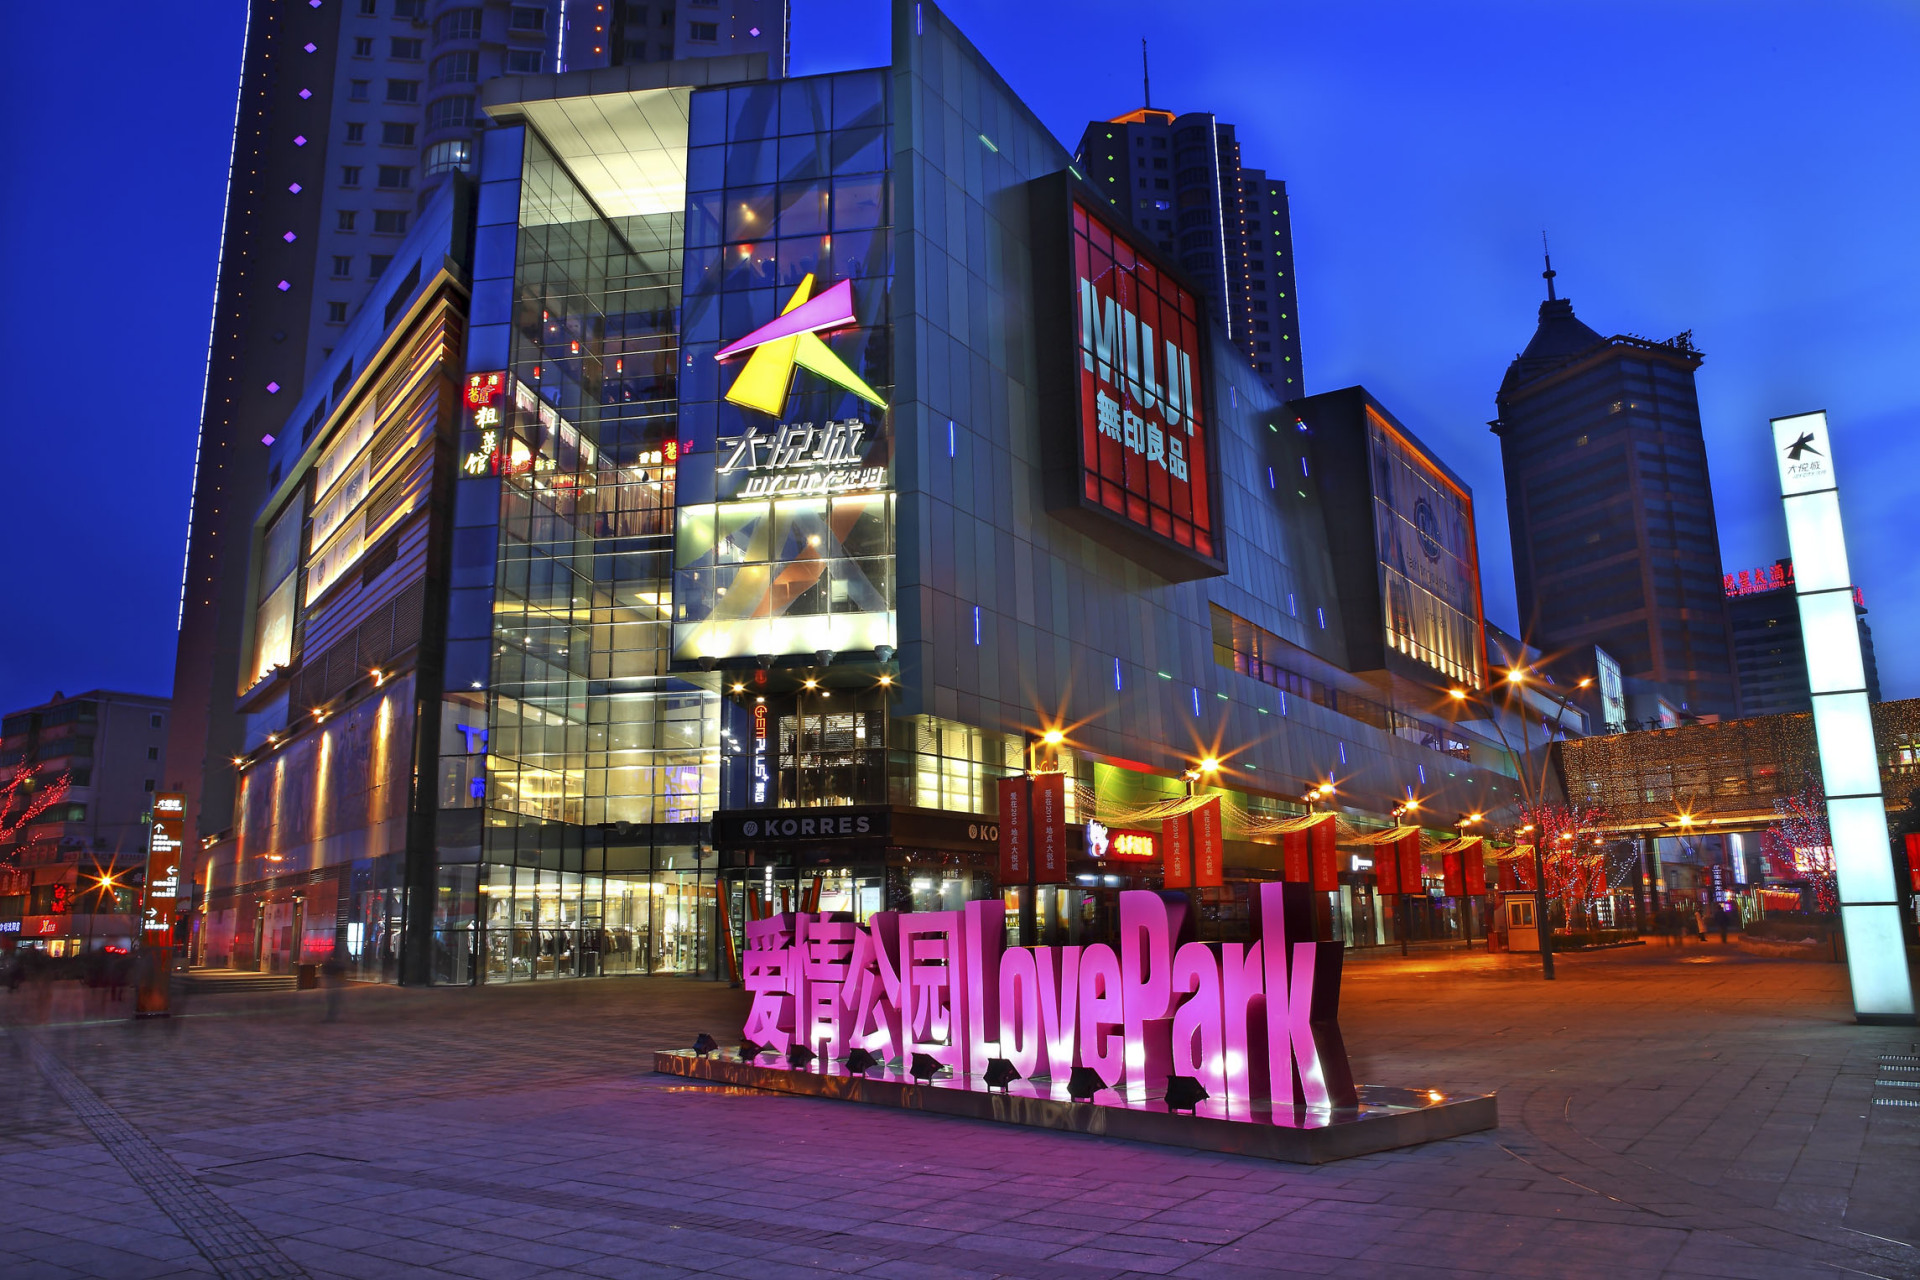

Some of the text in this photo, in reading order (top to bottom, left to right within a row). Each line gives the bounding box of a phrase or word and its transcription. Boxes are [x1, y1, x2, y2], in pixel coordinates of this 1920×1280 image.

[1080, 277, 1194, 437] MUJI
[464, 406, 498, 475] 粗菜馆
[716, 418, 865, 475] 大悦城
[1096, 389, 1189, 484] 無印良品
[765, 816, 870, 837] KORRES
[1011, 846, 1019, 872] 大悦城
[1044, 789, 1055, 870] 爱在2010 地点 大悦城
[811, 868, 853, 877] KORRES
[743, 881, 1345, 1110] 爱情公园 LovePark
